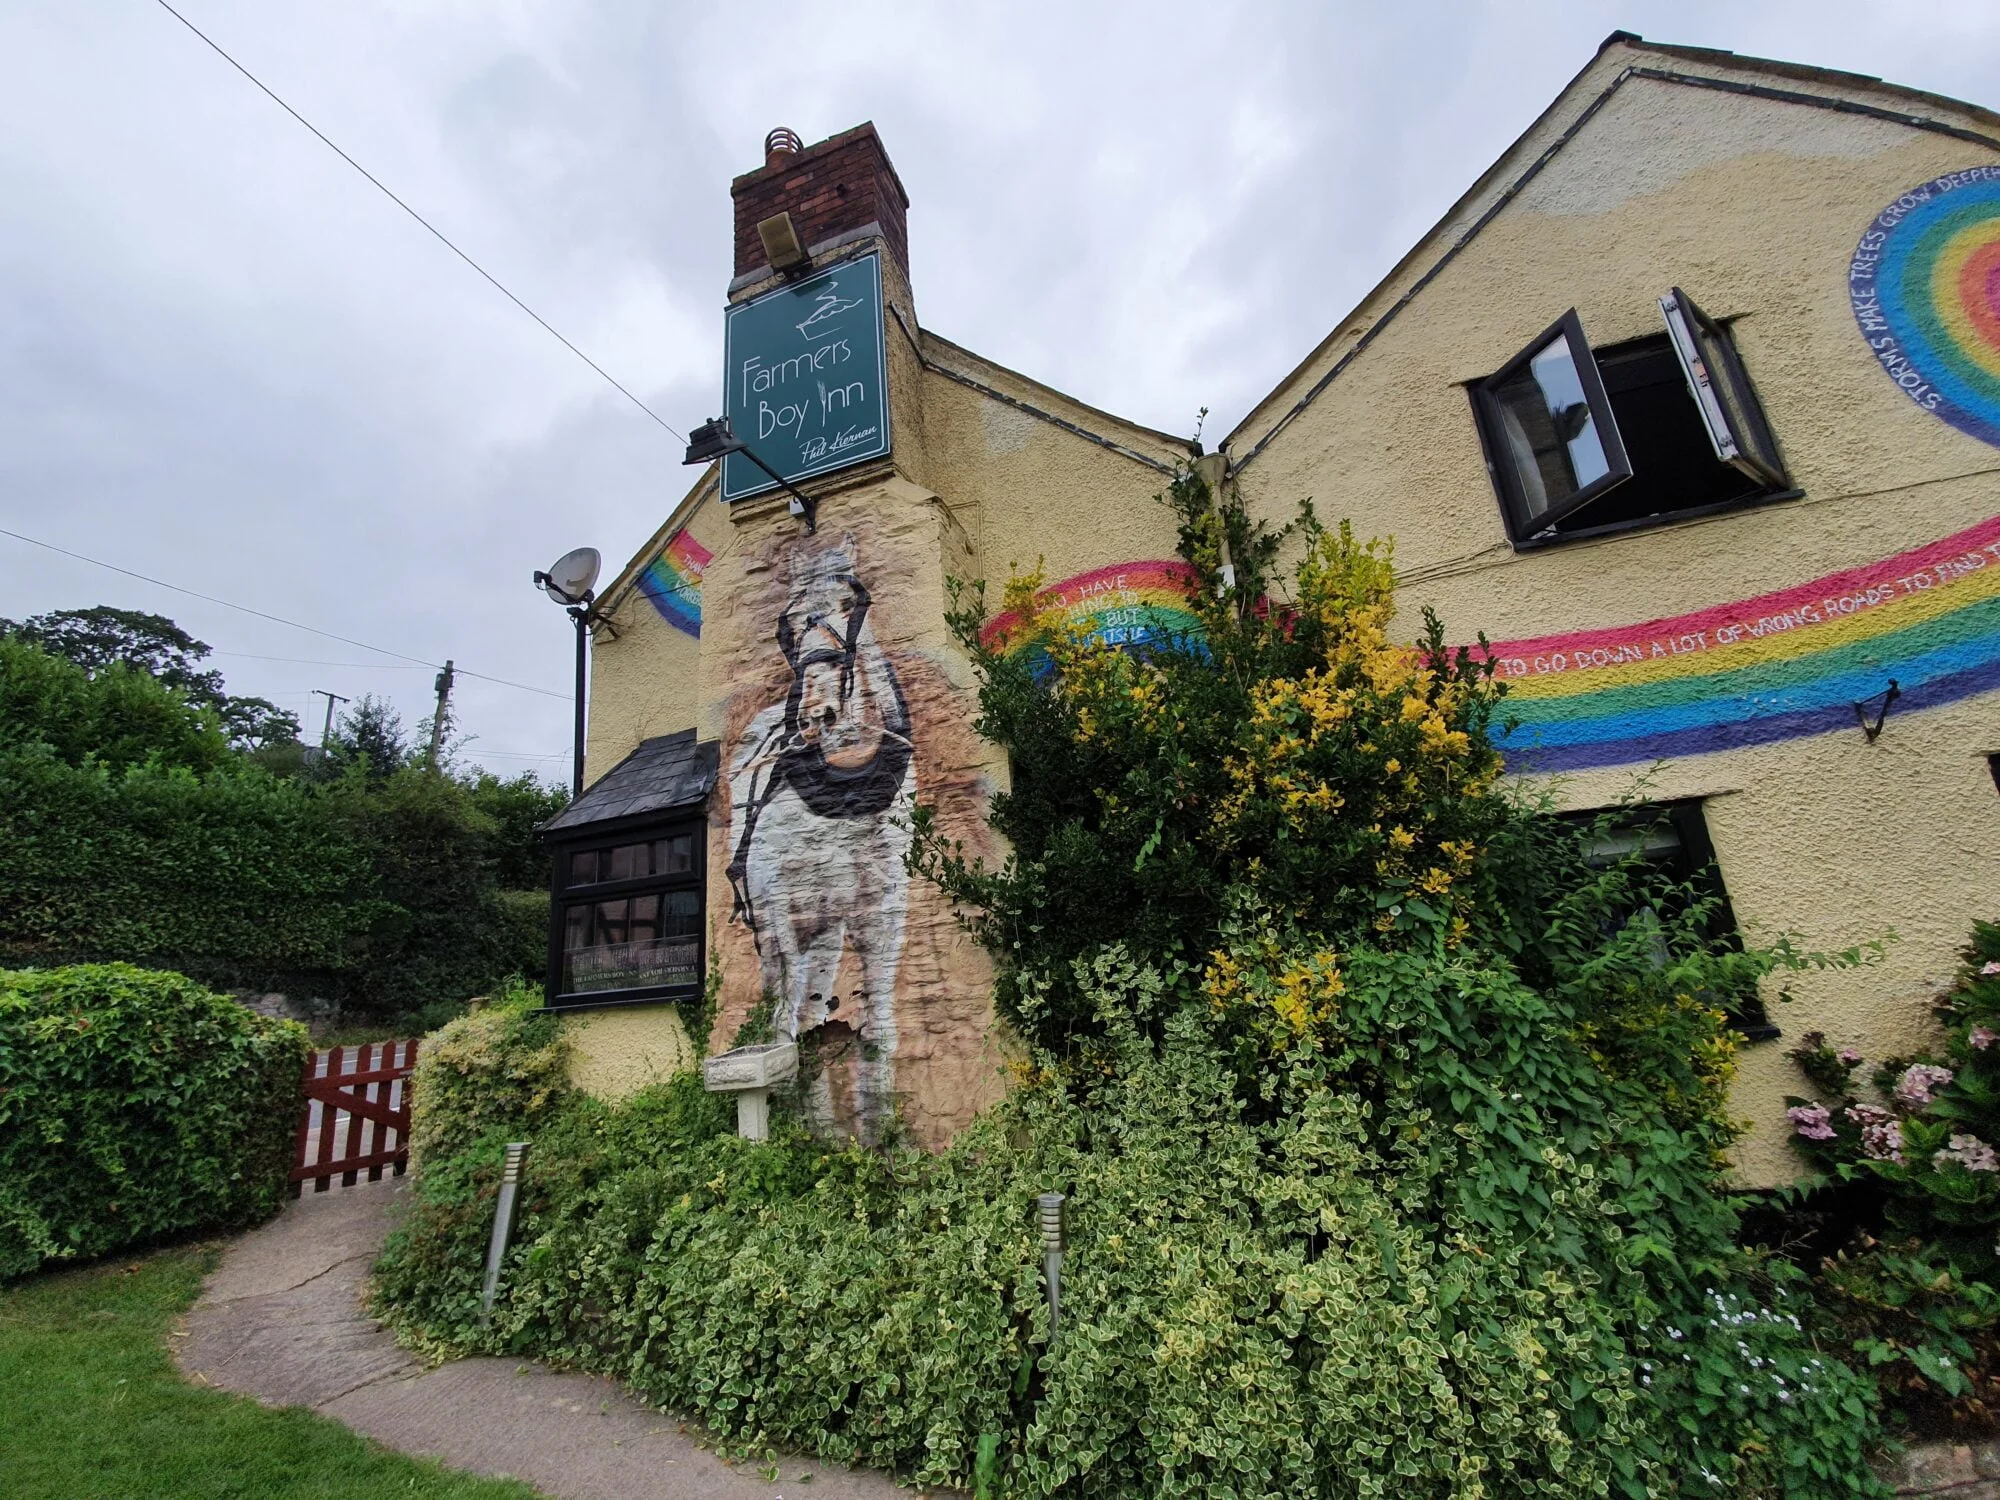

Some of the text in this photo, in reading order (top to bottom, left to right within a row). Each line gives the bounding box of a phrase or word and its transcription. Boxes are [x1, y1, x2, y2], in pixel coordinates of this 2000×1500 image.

[1878, 187, 1932, 228] GROW
[1850, 229, 1886, 281] TREES
[1851, 287, 1888, 331] MAKE
[742, 338, 851, 408] Farmers
[1871, 337, 1942, 410] STORMS
[759, 380, 865, 440] Boy Inn
[798, 436, 827, 464] Phil
[1079, 574, 1129, 598] HAVE
[1106, 607, 1140, 627] BUT
[1499, 659, 1528, 676] TO
[1534, 653, 1567, 674] GO
[1574, 645, 1643, 669] DOWN
[1651, 642, 1667, 658] A
[1670, 632, 1707, 654] LOT
[1716, 624, 1744, 645] OF
[1744, 605, 1822, 638] WRONG
[1823, 583, 1895, 617] ROADS
[1897, 572, 1932, 593] TO
[1934, 552, 1987, 579] FIND
